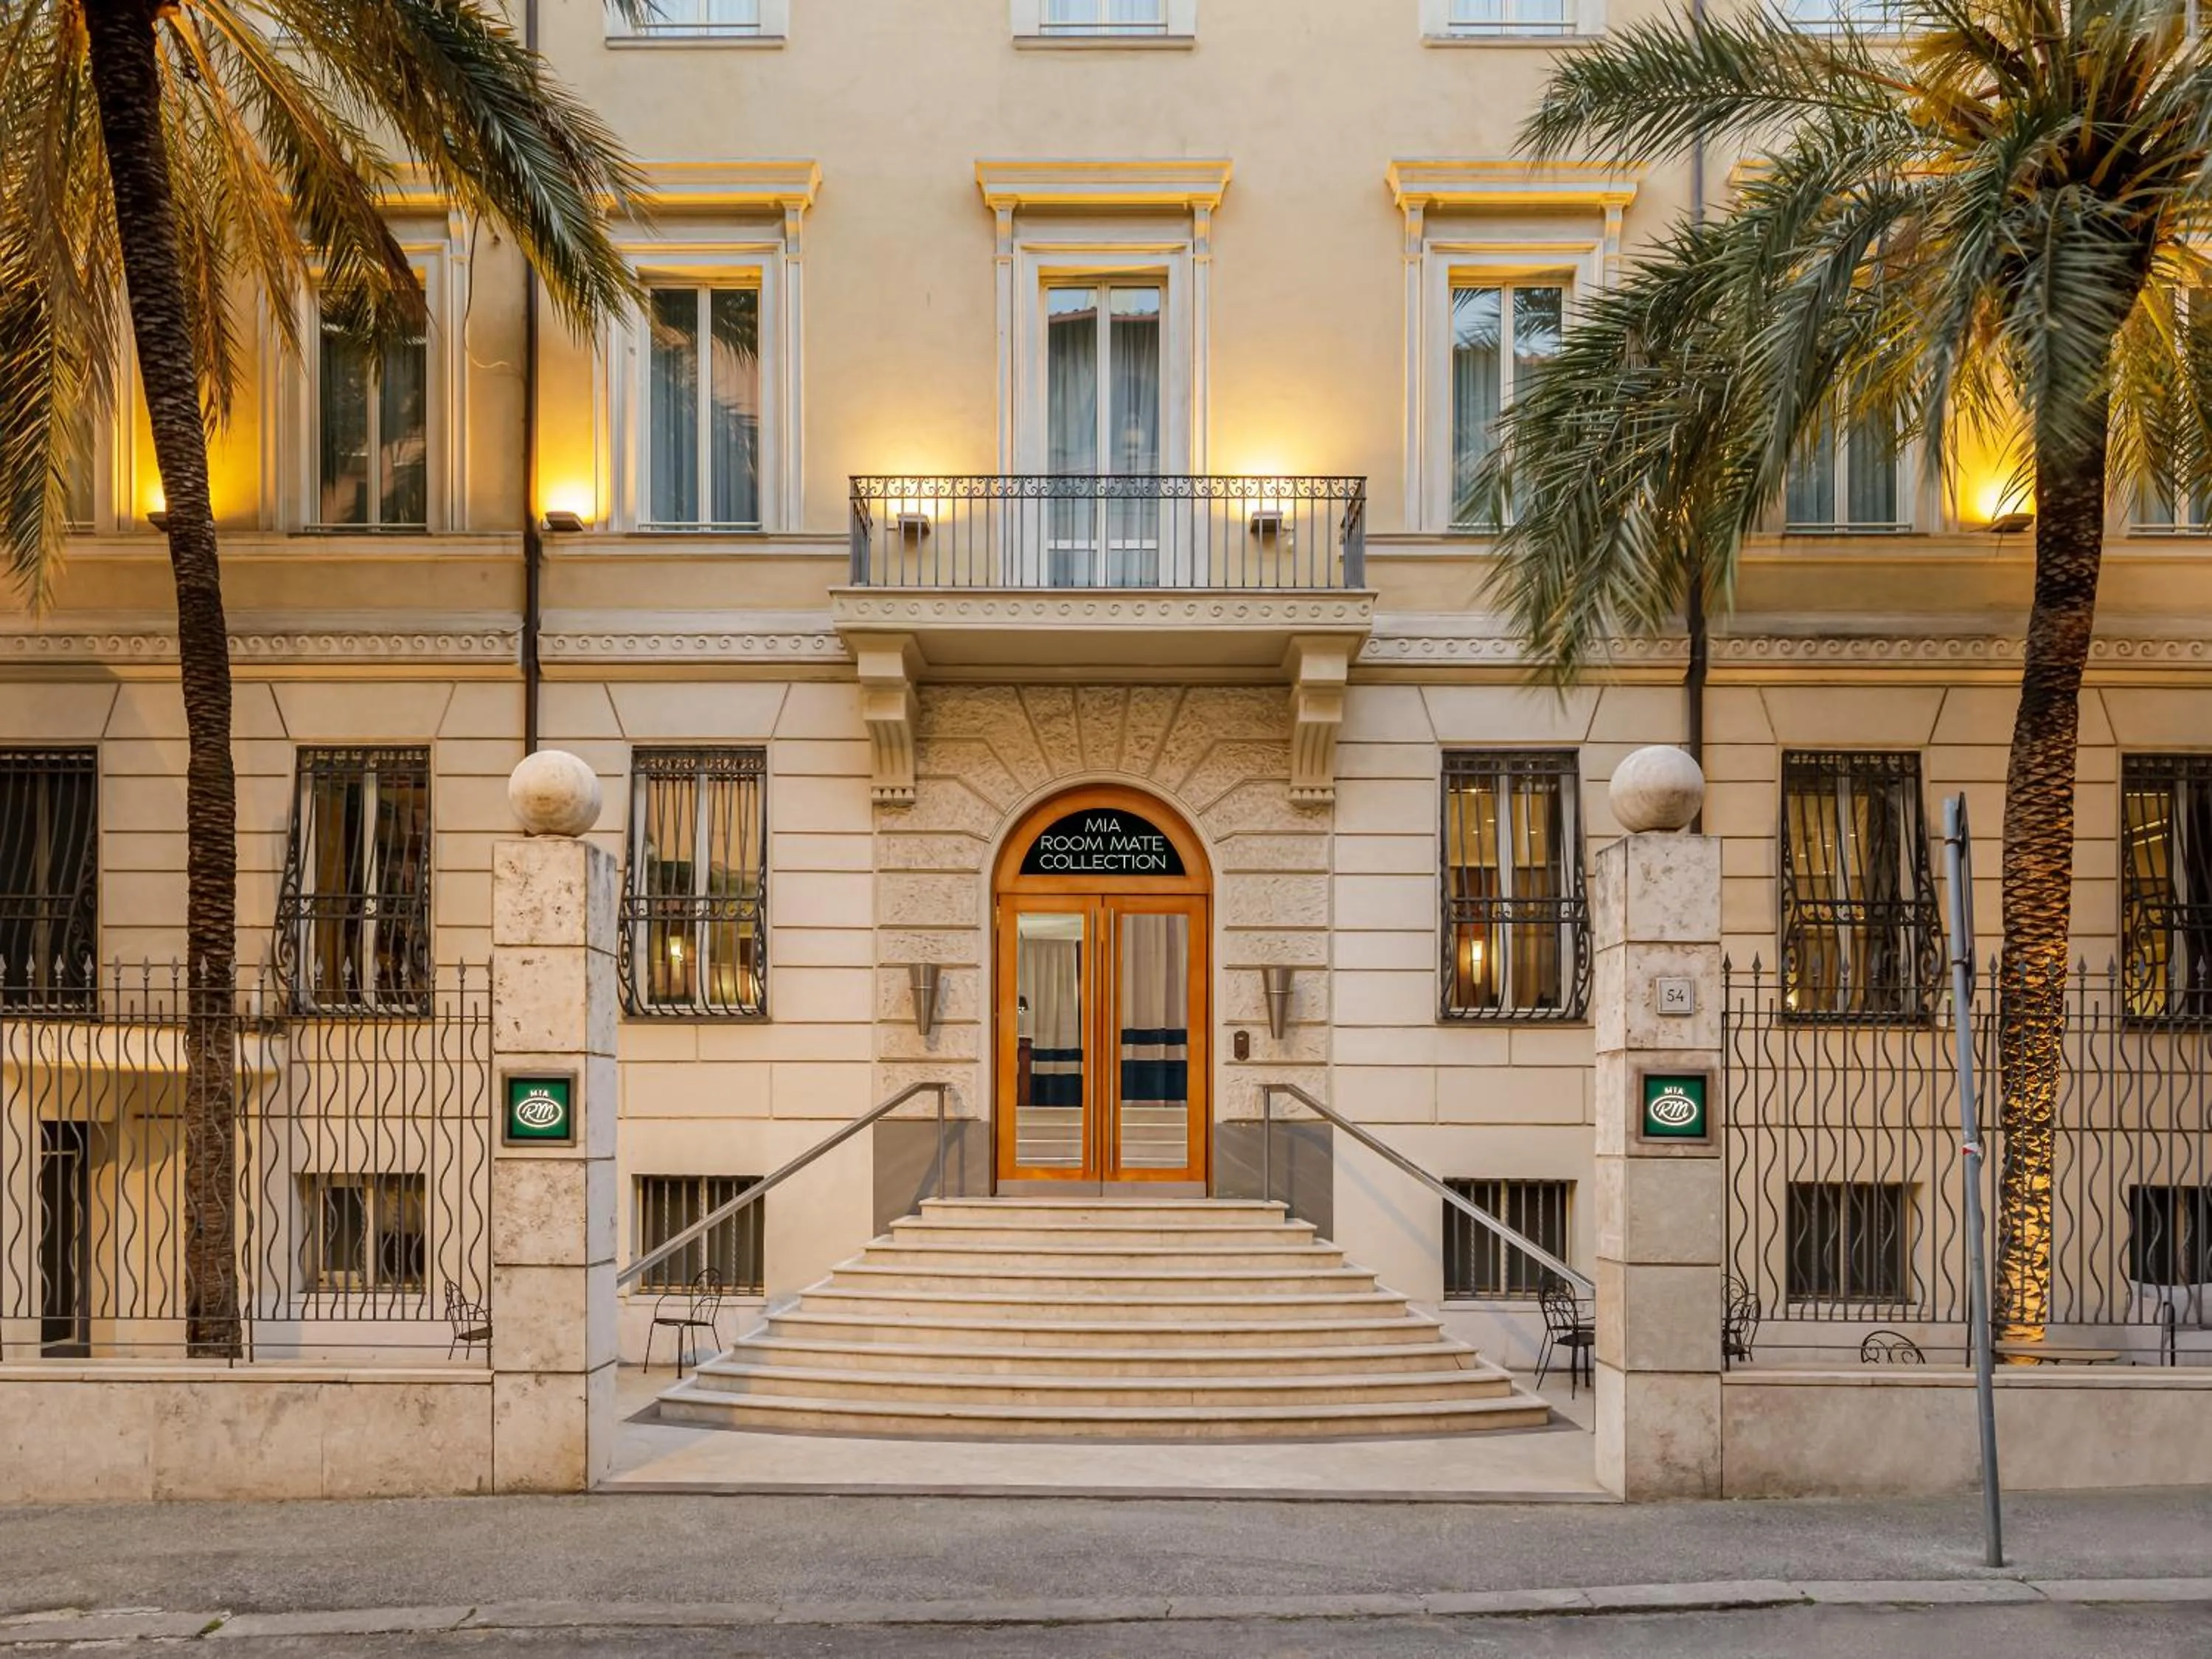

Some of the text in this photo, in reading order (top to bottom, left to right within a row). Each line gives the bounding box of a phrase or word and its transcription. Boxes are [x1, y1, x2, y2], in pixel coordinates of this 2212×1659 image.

[1085, 818, 1121, 832] MIA
[1040, 835, 1164, 851] ROOM MATE
[1039, 854, 1166, 869] COLLECTION
[1666, 989, 1684, 1002] 54
[1664, 1086, 1683, 1095] MIA
